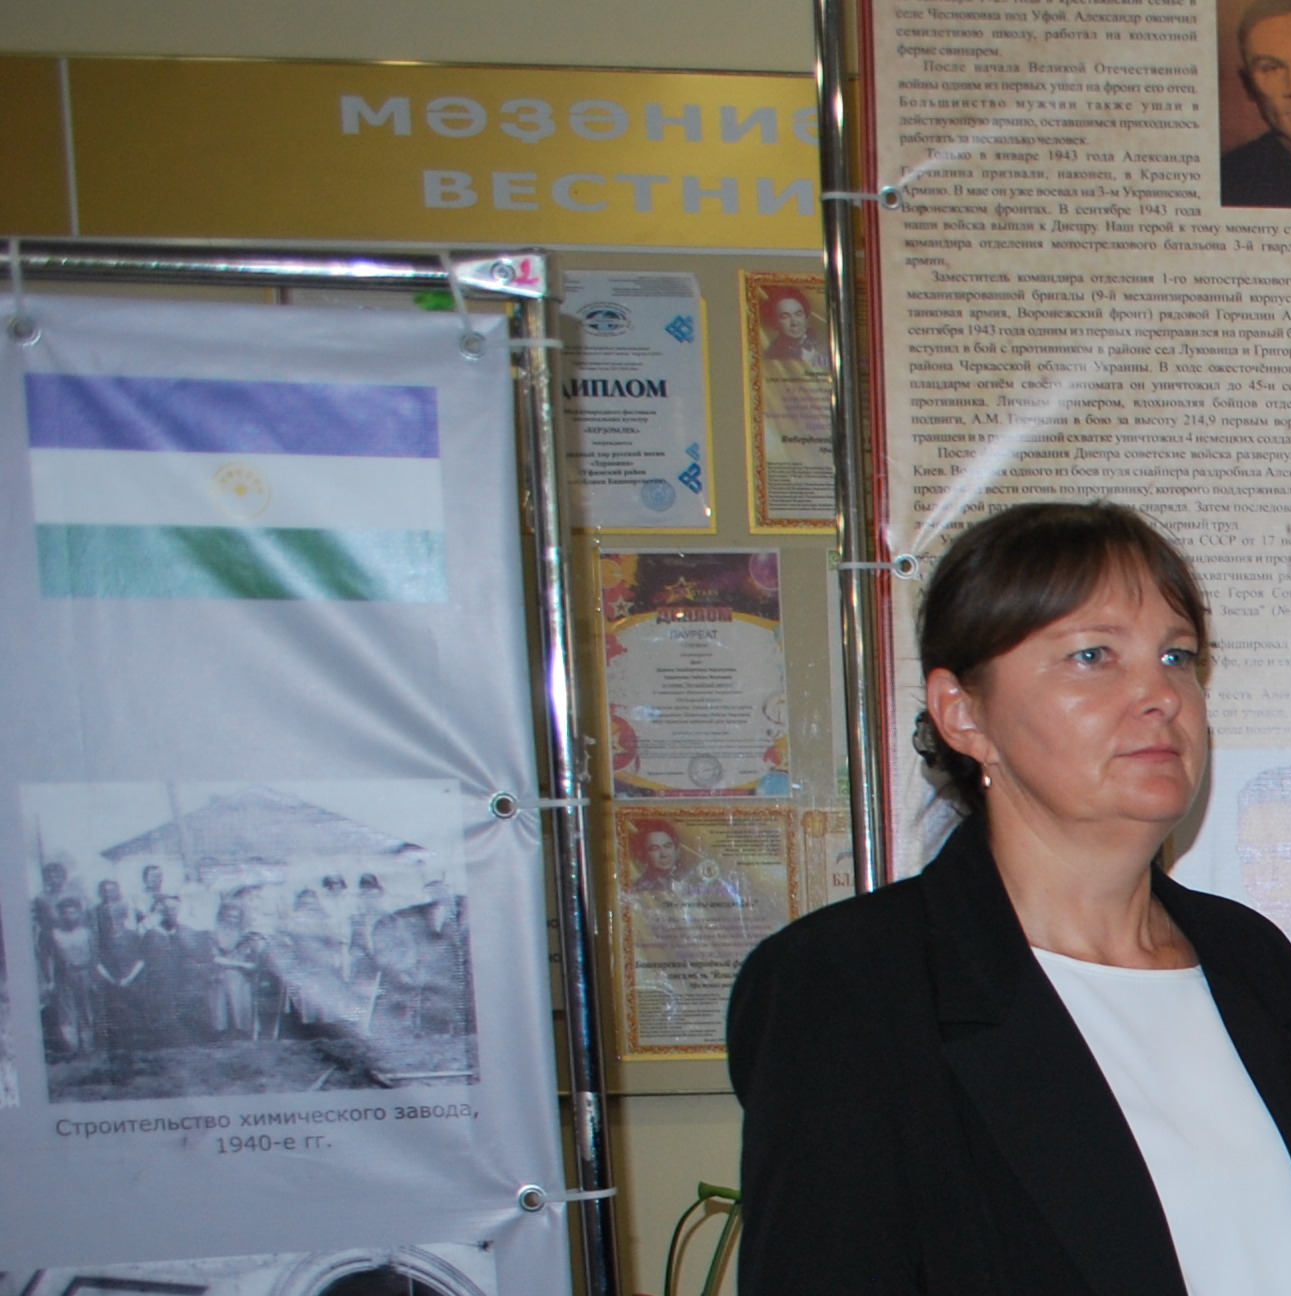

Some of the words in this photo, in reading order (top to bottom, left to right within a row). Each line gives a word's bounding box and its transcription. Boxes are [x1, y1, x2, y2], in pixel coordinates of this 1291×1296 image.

[423, 169, 816, 216] ВЕСТНИ
[669, 629, 718, 640] ЛАУРЕАТ
[56, 1112, 231, 1137] Строительство
[240, 1107, 386, 1127] химического
[394, 1103, 479, 1122] завода,
[217, 1134, 296, 1153] 1940-е
[304, 1136, 331, 1149] гг.
